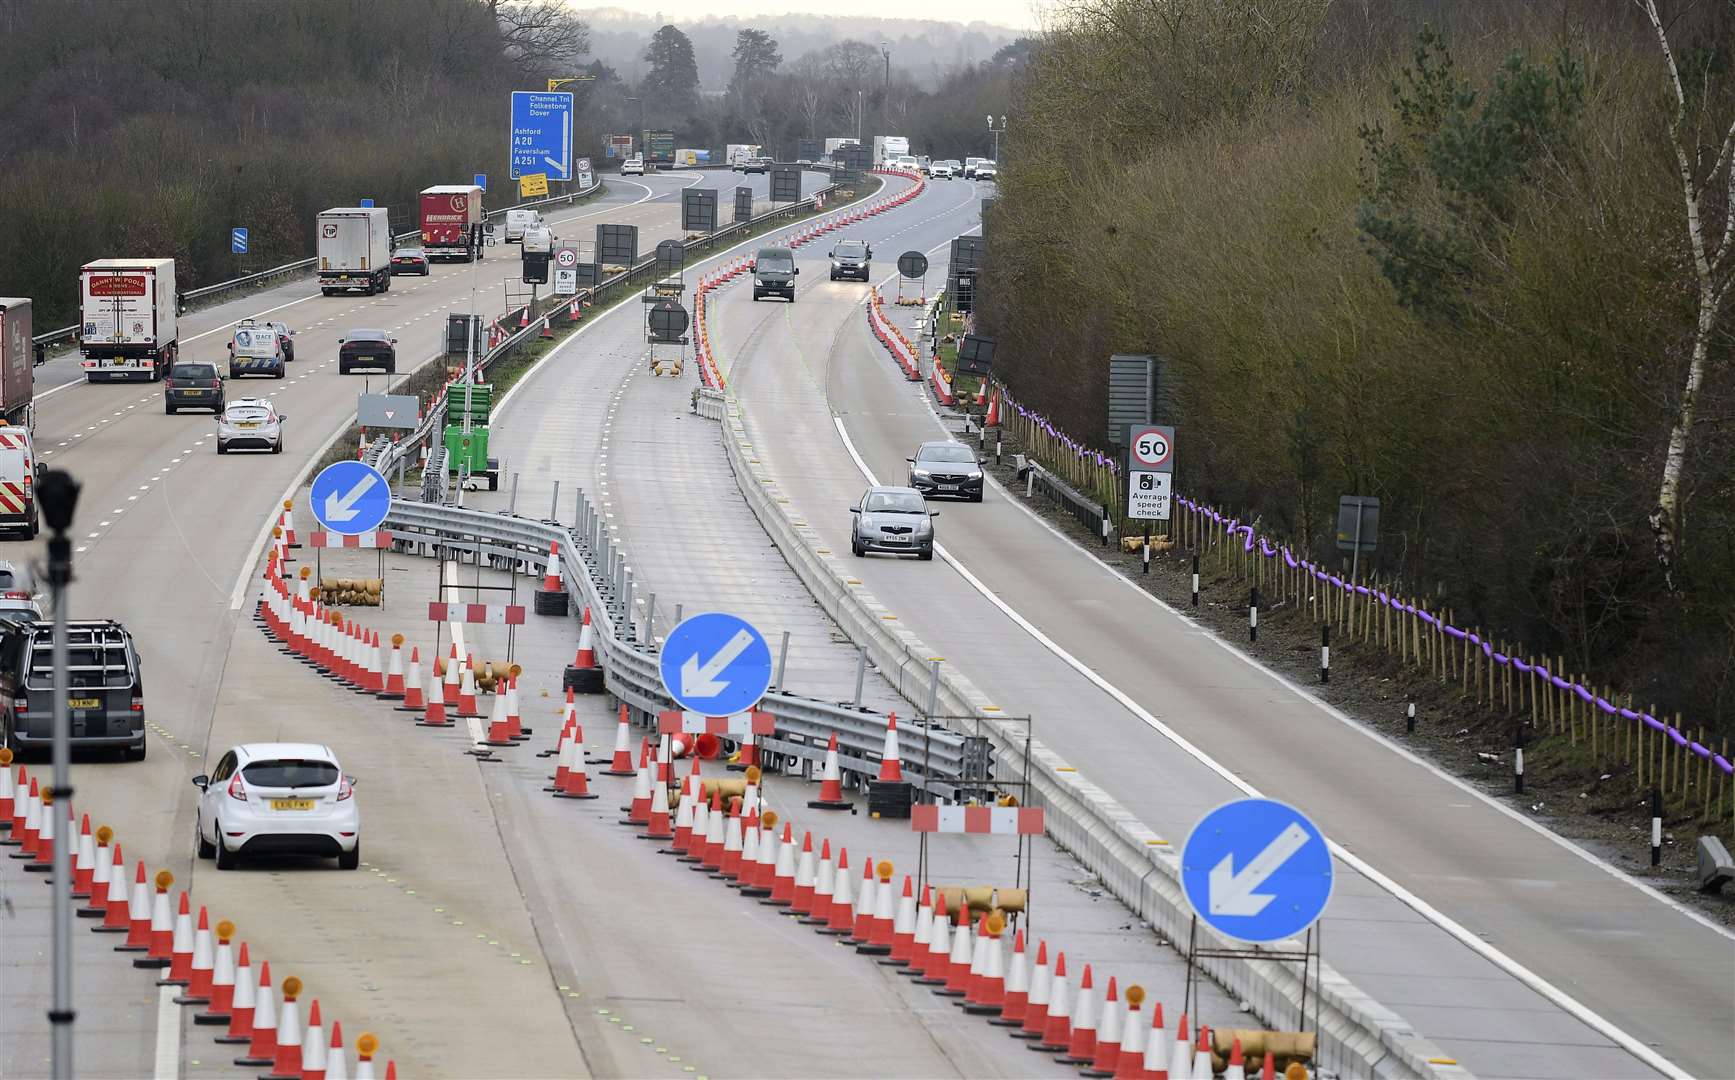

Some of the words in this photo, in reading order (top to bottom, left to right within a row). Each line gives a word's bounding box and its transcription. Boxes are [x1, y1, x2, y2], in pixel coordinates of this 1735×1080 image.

[425, 214, 464, 223] HENDRICK
[560, 254, 574, 263] 50
[91, 278, 113, 289] DANNY
[123, 277, 145, 288] POOLE
[1139, 440, 1166, 456] 50
[1132, 492, 1168, 502] Average
[1137, 501, 1162, 509] speed
[1136, 509, 1162, 517] check
